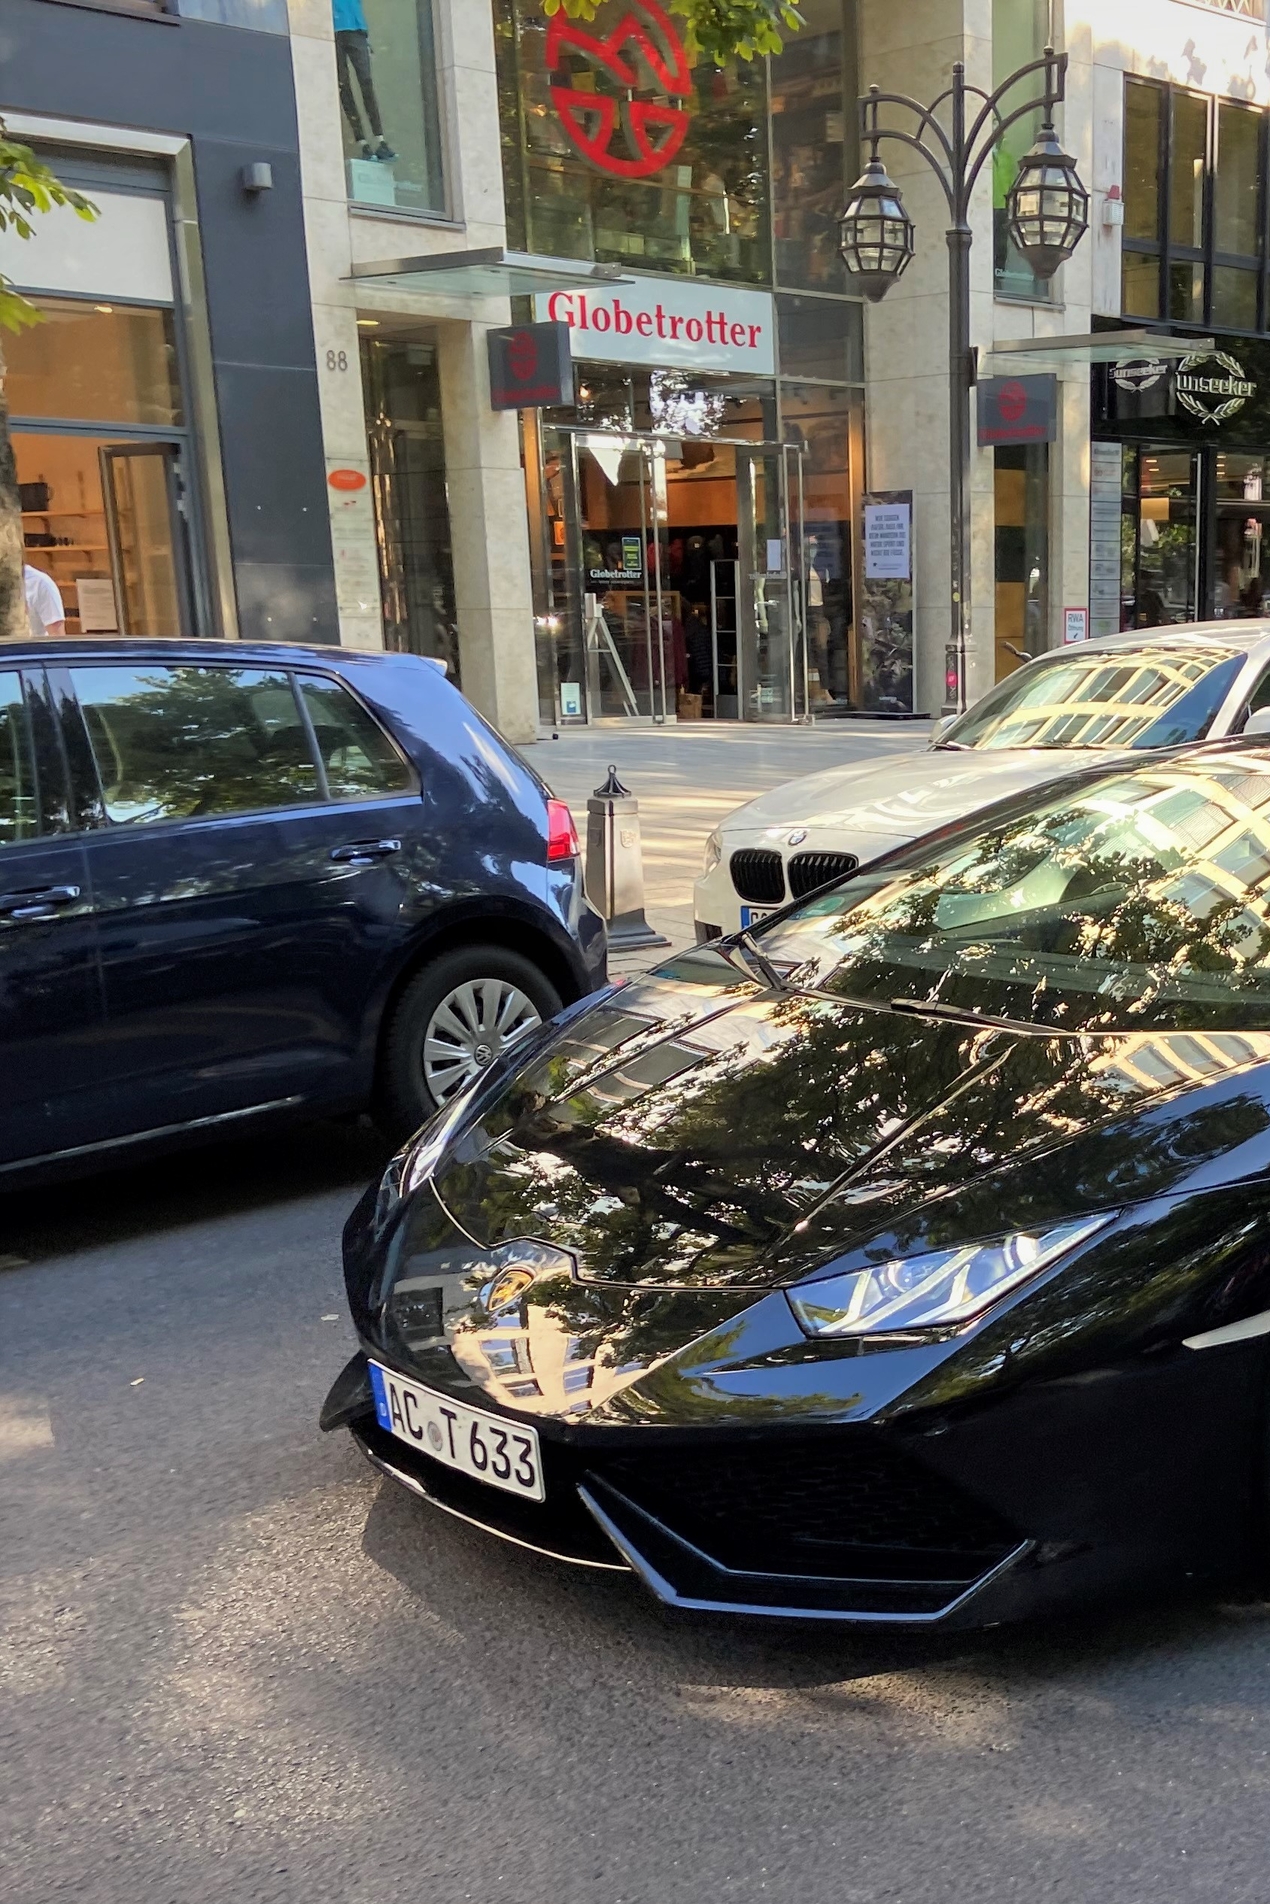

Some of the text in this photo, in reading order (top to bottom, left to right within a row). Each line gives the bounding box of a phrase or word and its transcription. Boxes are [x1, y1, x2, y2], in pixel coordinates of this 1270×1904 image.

[547, 291, 762, 348] Globetrotter
[326, 350, 348, 371] 88
[590, 569, 642, 578] Globetrotter
[389, 1382, 535, 1489] AC T 633
